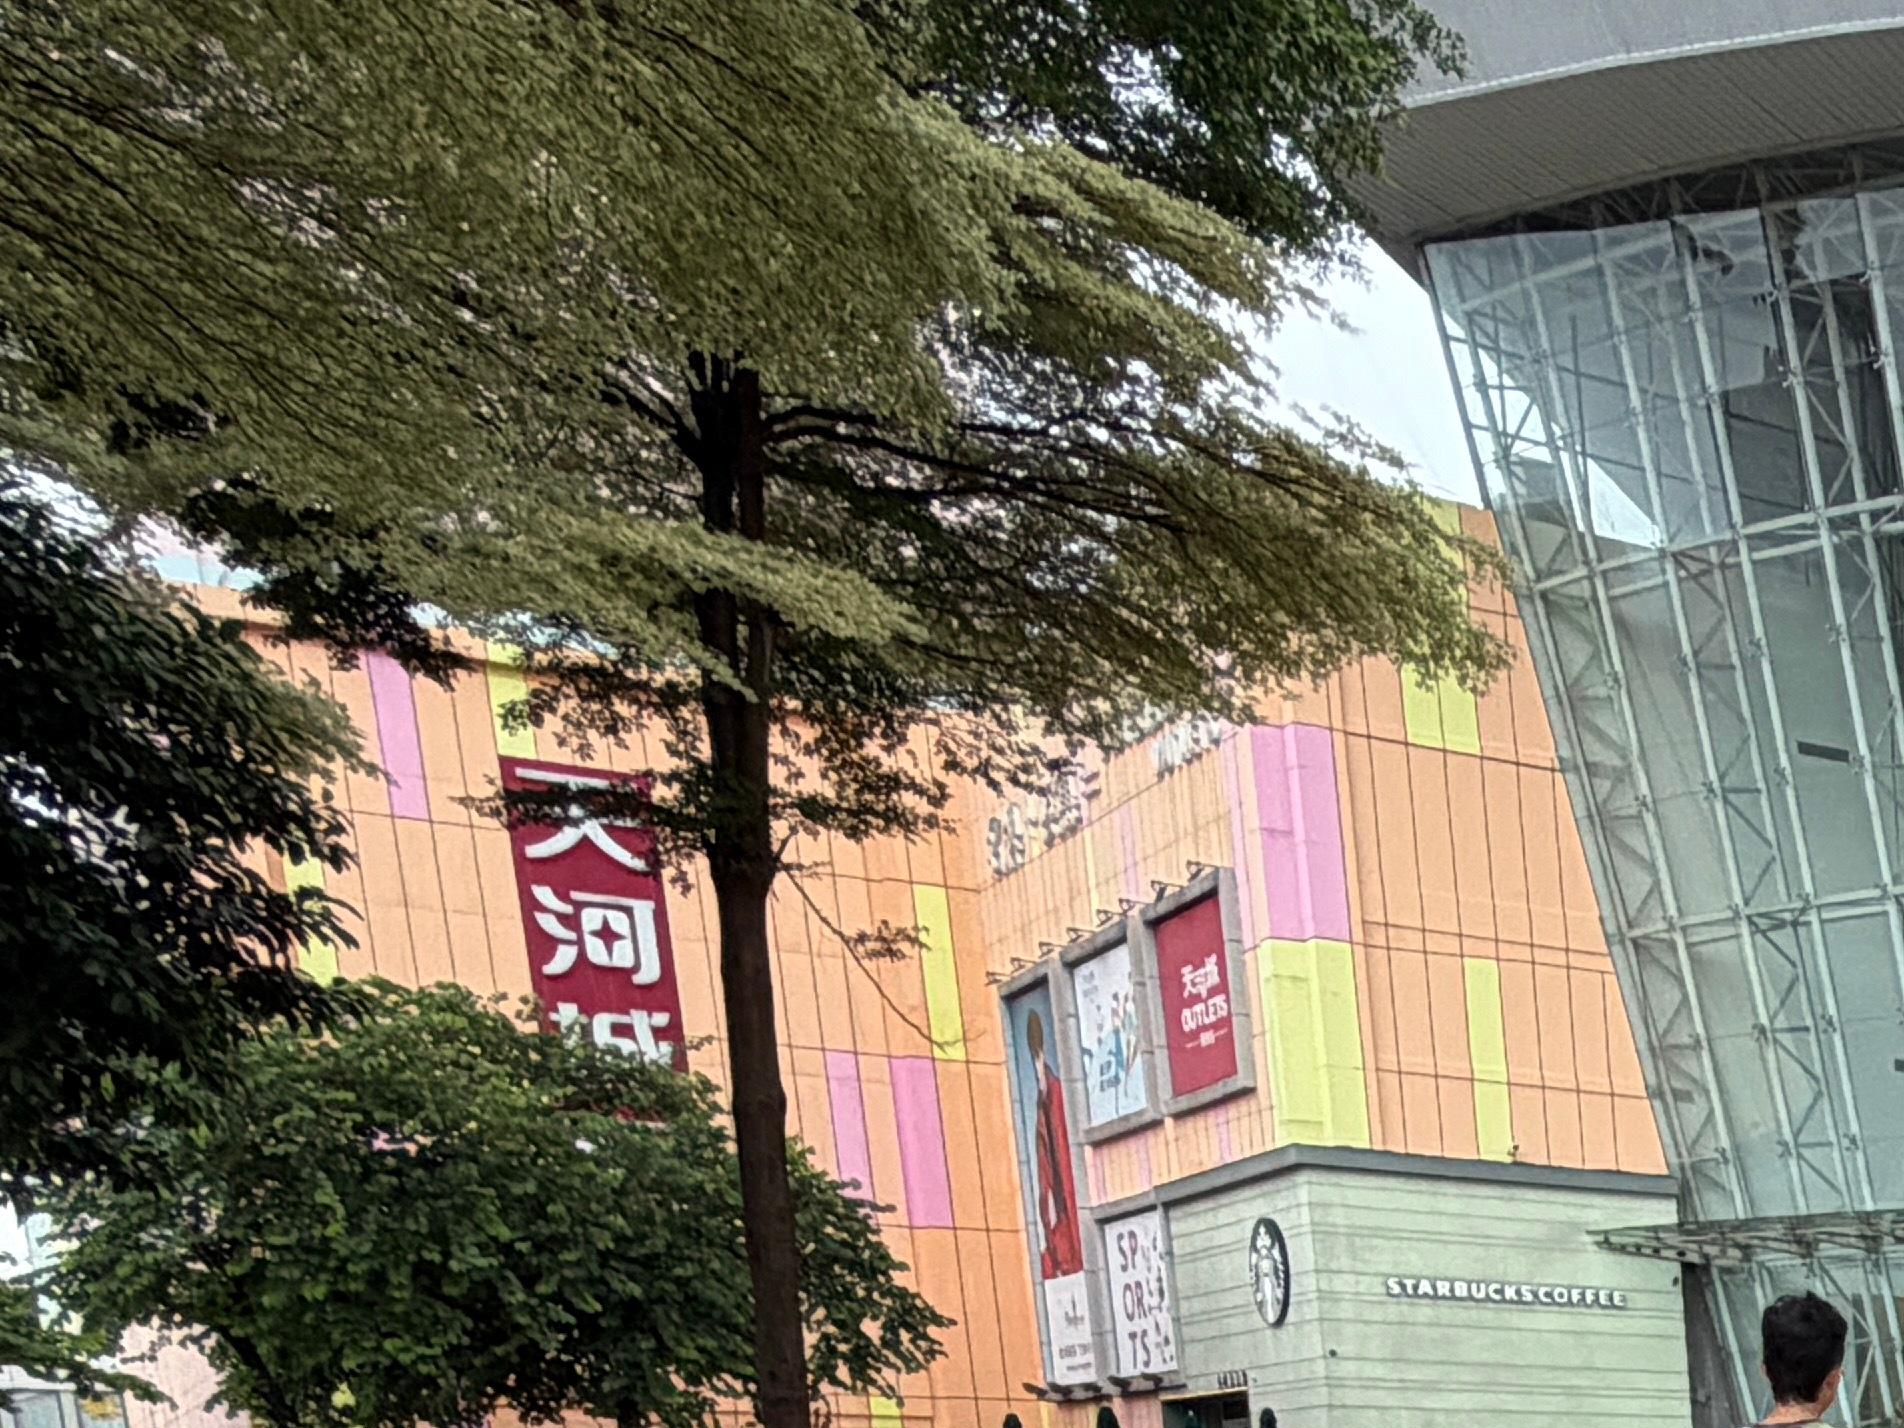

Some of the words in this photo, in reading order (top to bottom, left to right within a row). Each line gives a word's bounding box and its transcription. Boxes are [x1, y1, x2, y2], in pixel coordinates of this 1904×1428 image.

[1180, 994, 1229, 1032] OUTLETS
[1117, 1230, 1138, 1272] SP
[1122, 1280, 1148, 1322] OR
[1387, 1276, 1532, 1301] STARBUCKS
[1538, 1286, 1627, 1307] COFFEE
[1128, 1328, 1150, 1369] TS
